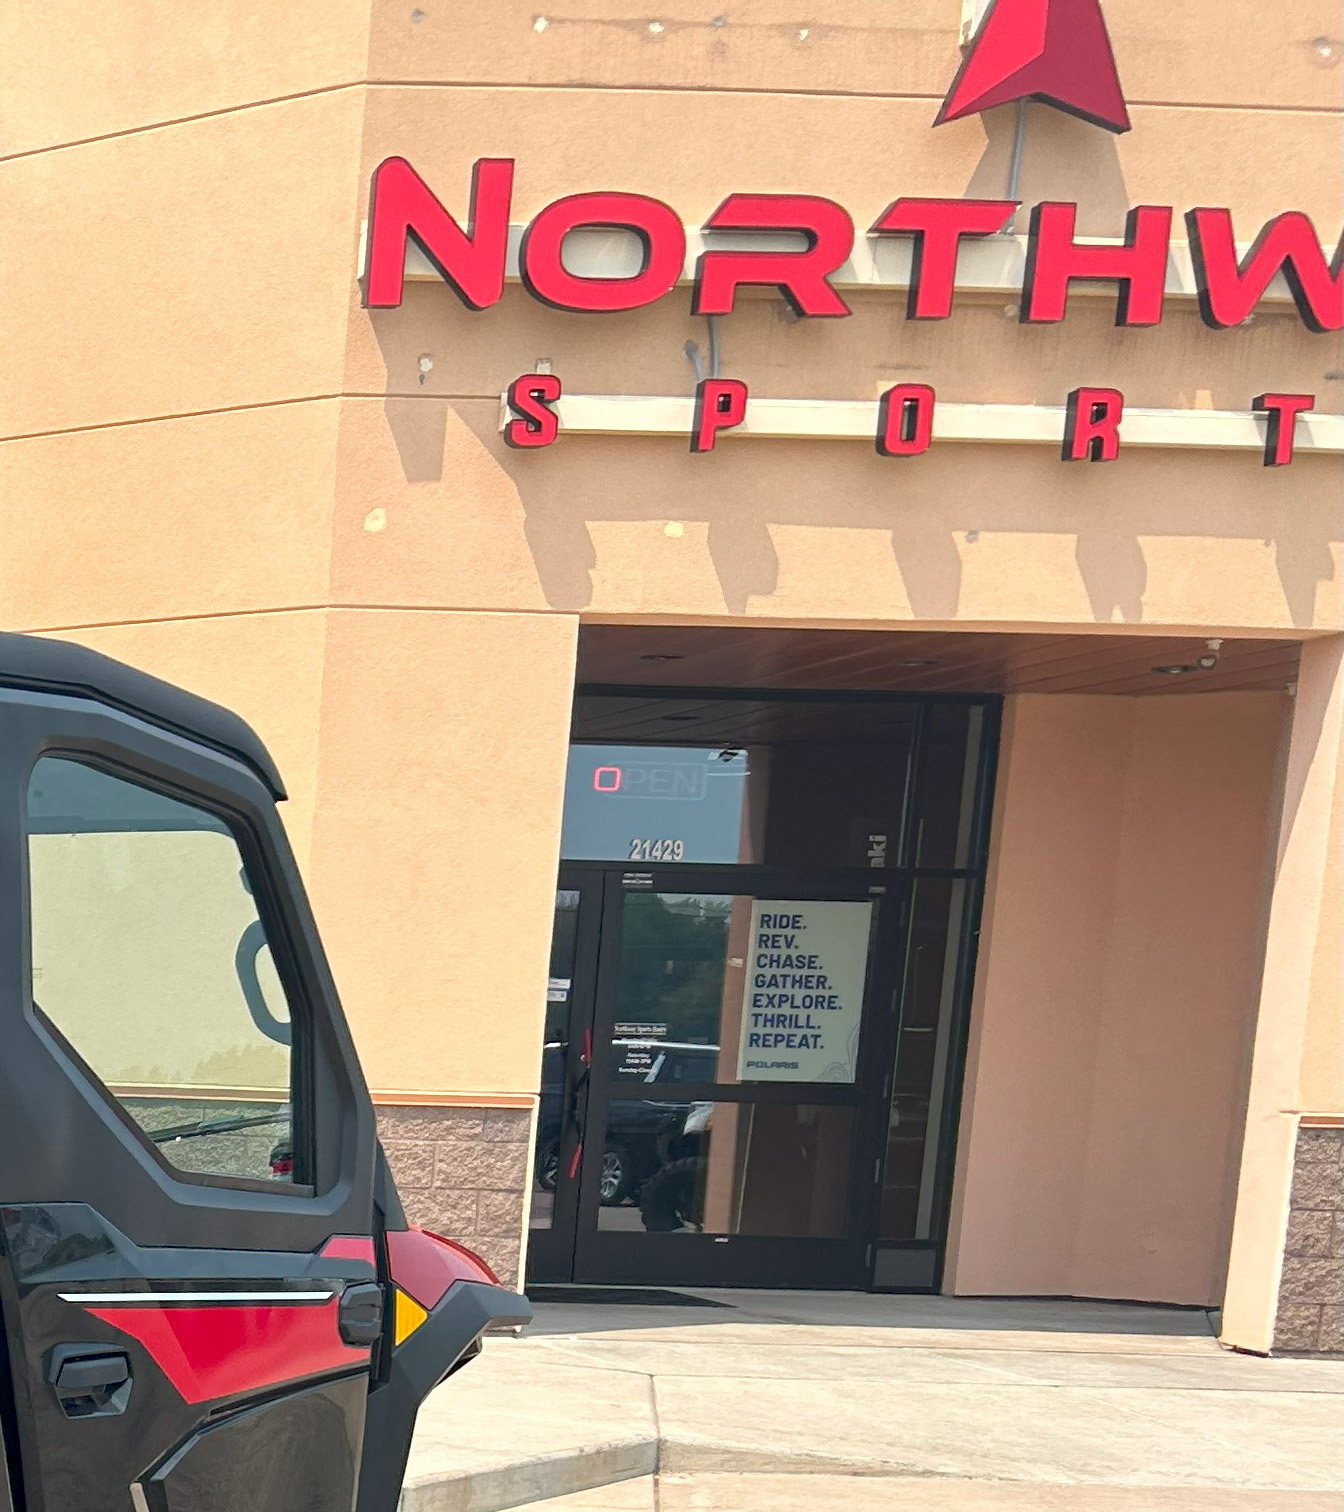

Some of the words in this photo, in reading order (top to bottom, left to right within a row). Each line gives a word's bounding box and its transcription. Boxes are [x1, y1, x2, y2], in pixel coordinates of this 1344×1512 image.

[629, 839, 684, 860] 21429
[760, 913, 807, 930] RIDE.
[757, 934, 799, 950] REV.
[756, 953, 823, 970] CHASE.
[754, 973, 833, 990] GATHER.
[752, 993, 843, 1011] EXPLORE.
[751, 1013, 822, 1029] THRILL.
[748, 1032, 825, 1050] REPEAT.
[746, 1060, 800, 1070] POLARIS
